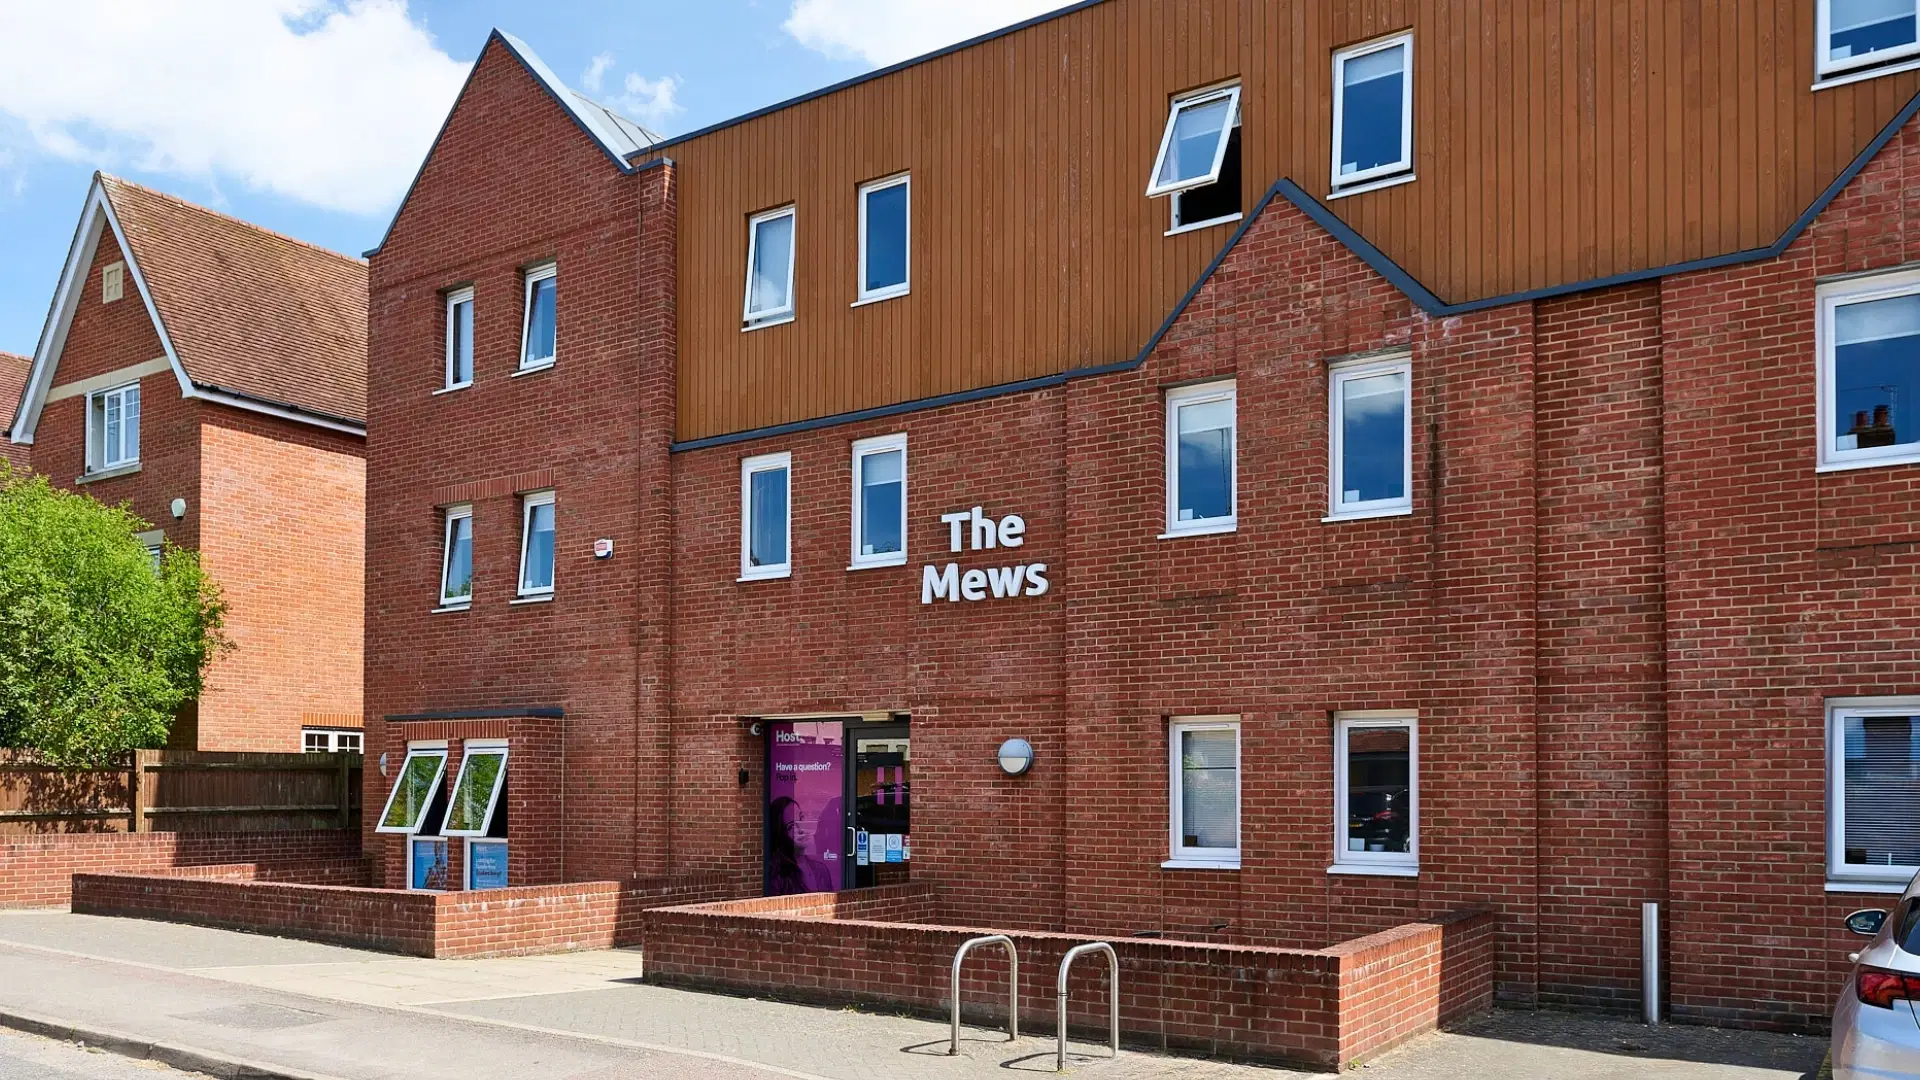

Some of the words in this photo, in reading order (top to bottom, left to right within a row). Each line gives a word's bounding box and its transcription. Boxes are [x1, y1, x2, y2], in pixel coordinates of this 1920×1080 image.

[941, 506, 1026, 553] The
[921, 563, 1049, 604] Mews
[776, 762, 793, 771] Have
[799, 762, 831, 772] question?
